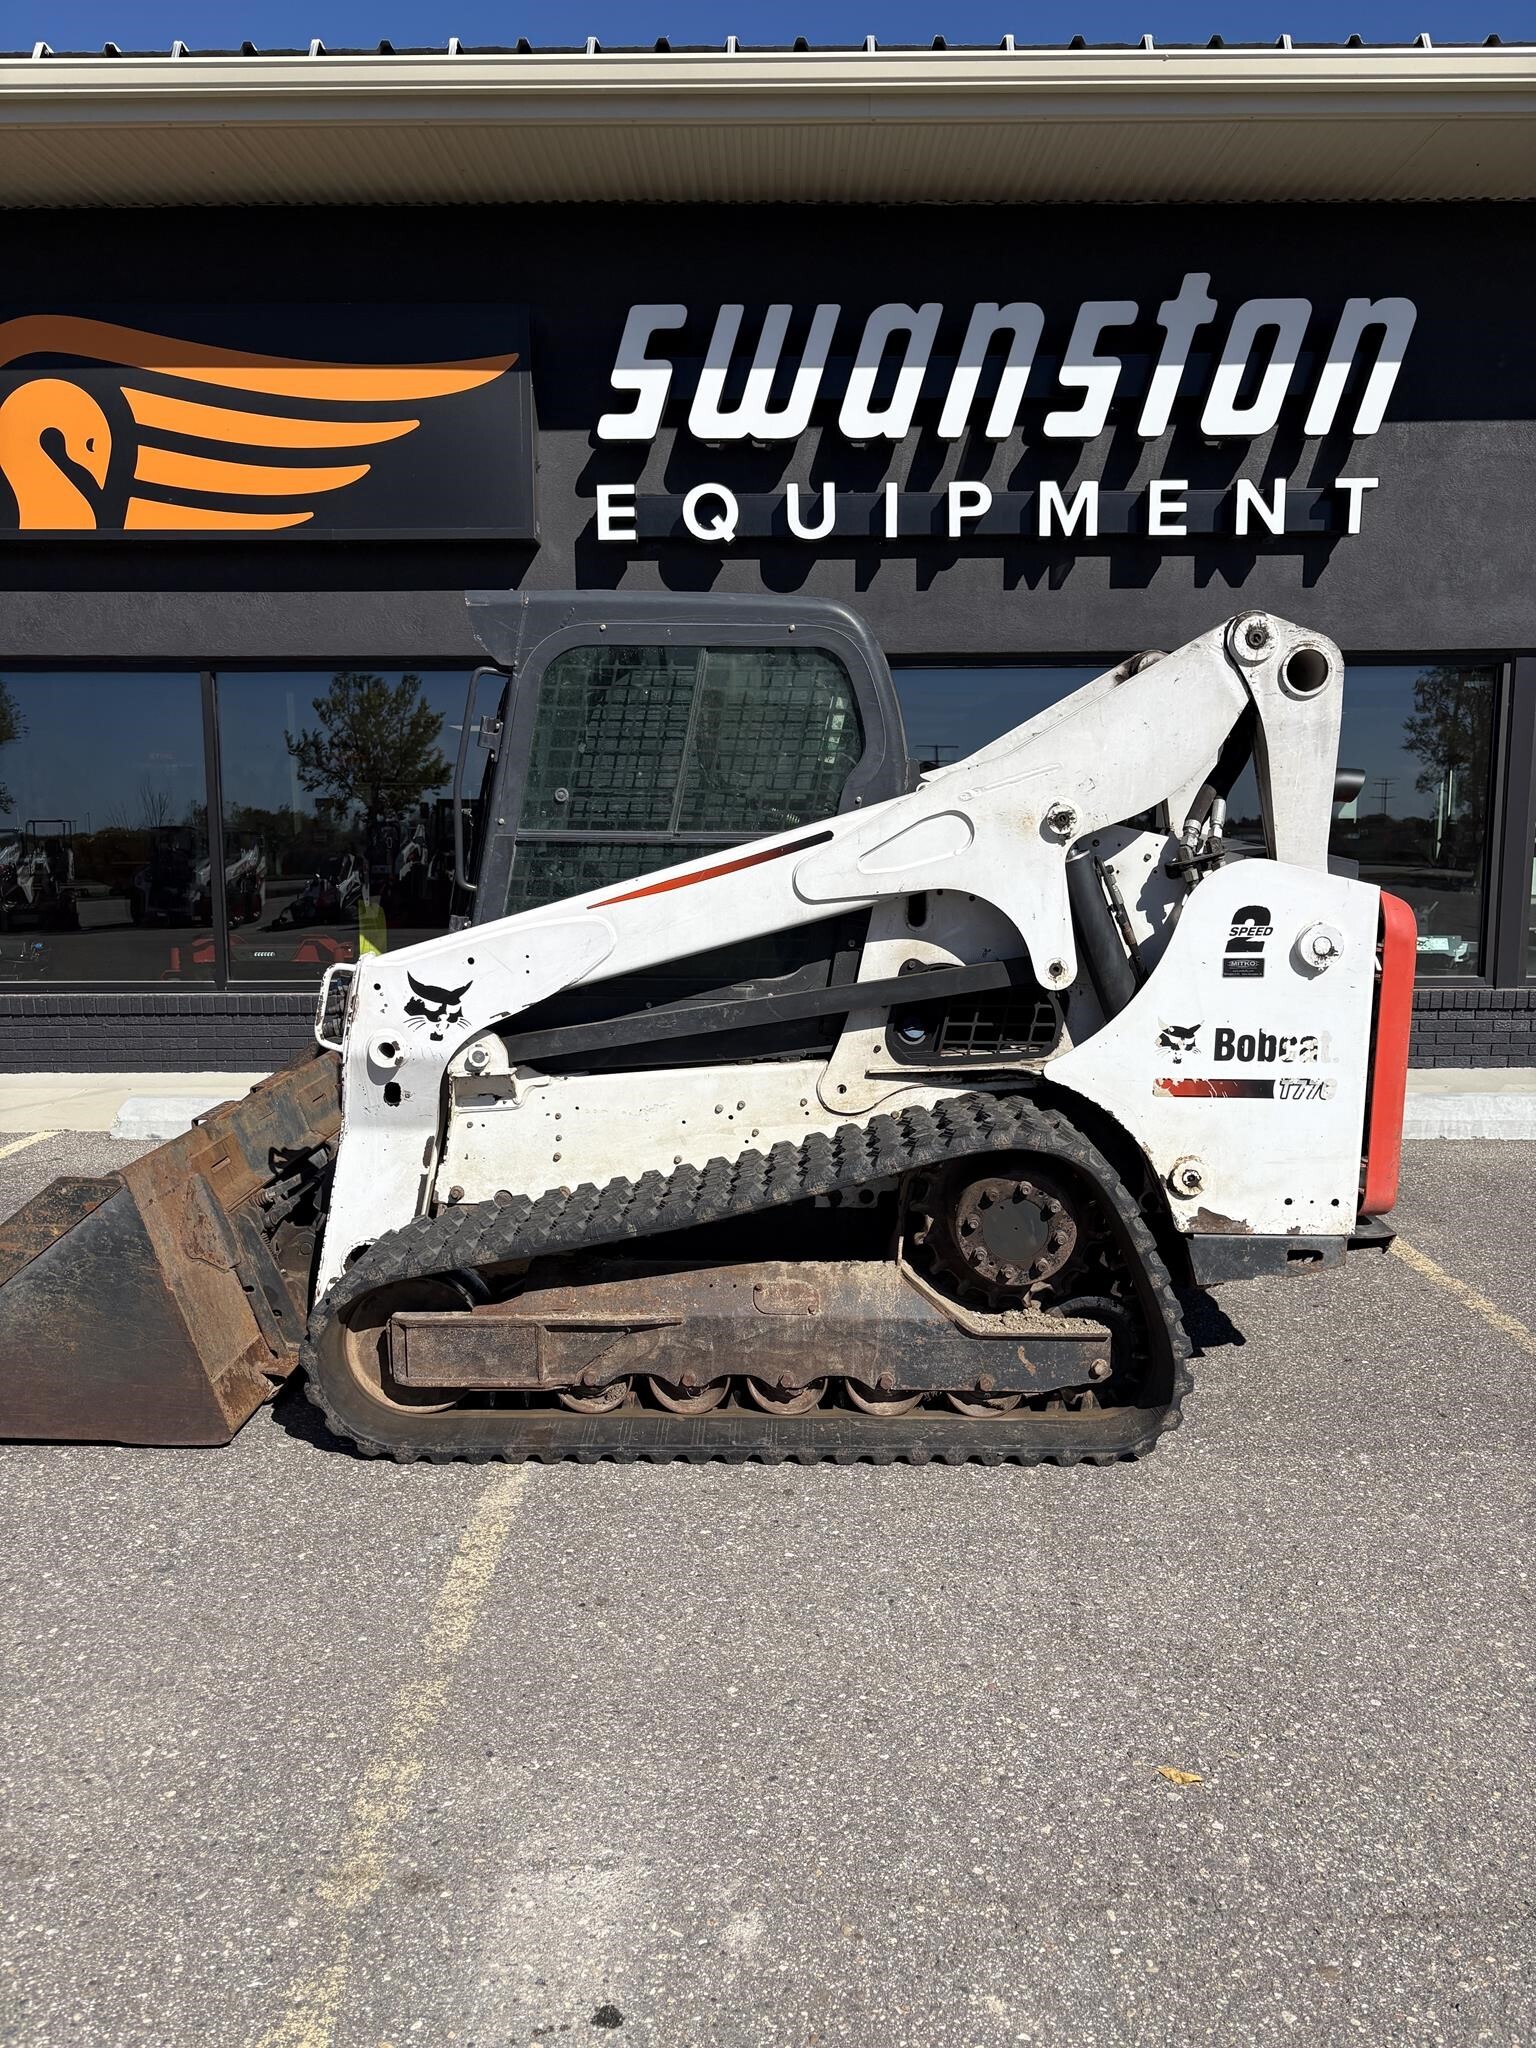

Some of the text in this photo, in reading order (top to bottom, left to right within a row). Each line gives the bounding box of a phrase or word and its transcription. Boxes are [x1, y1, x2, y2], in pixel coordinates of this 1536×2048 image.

[596, 272, 1418, 441] swanston
[597, 477, 1380, 543] EQUIPMENT
[1225, 905, 1274, 953] 2 SPEED
